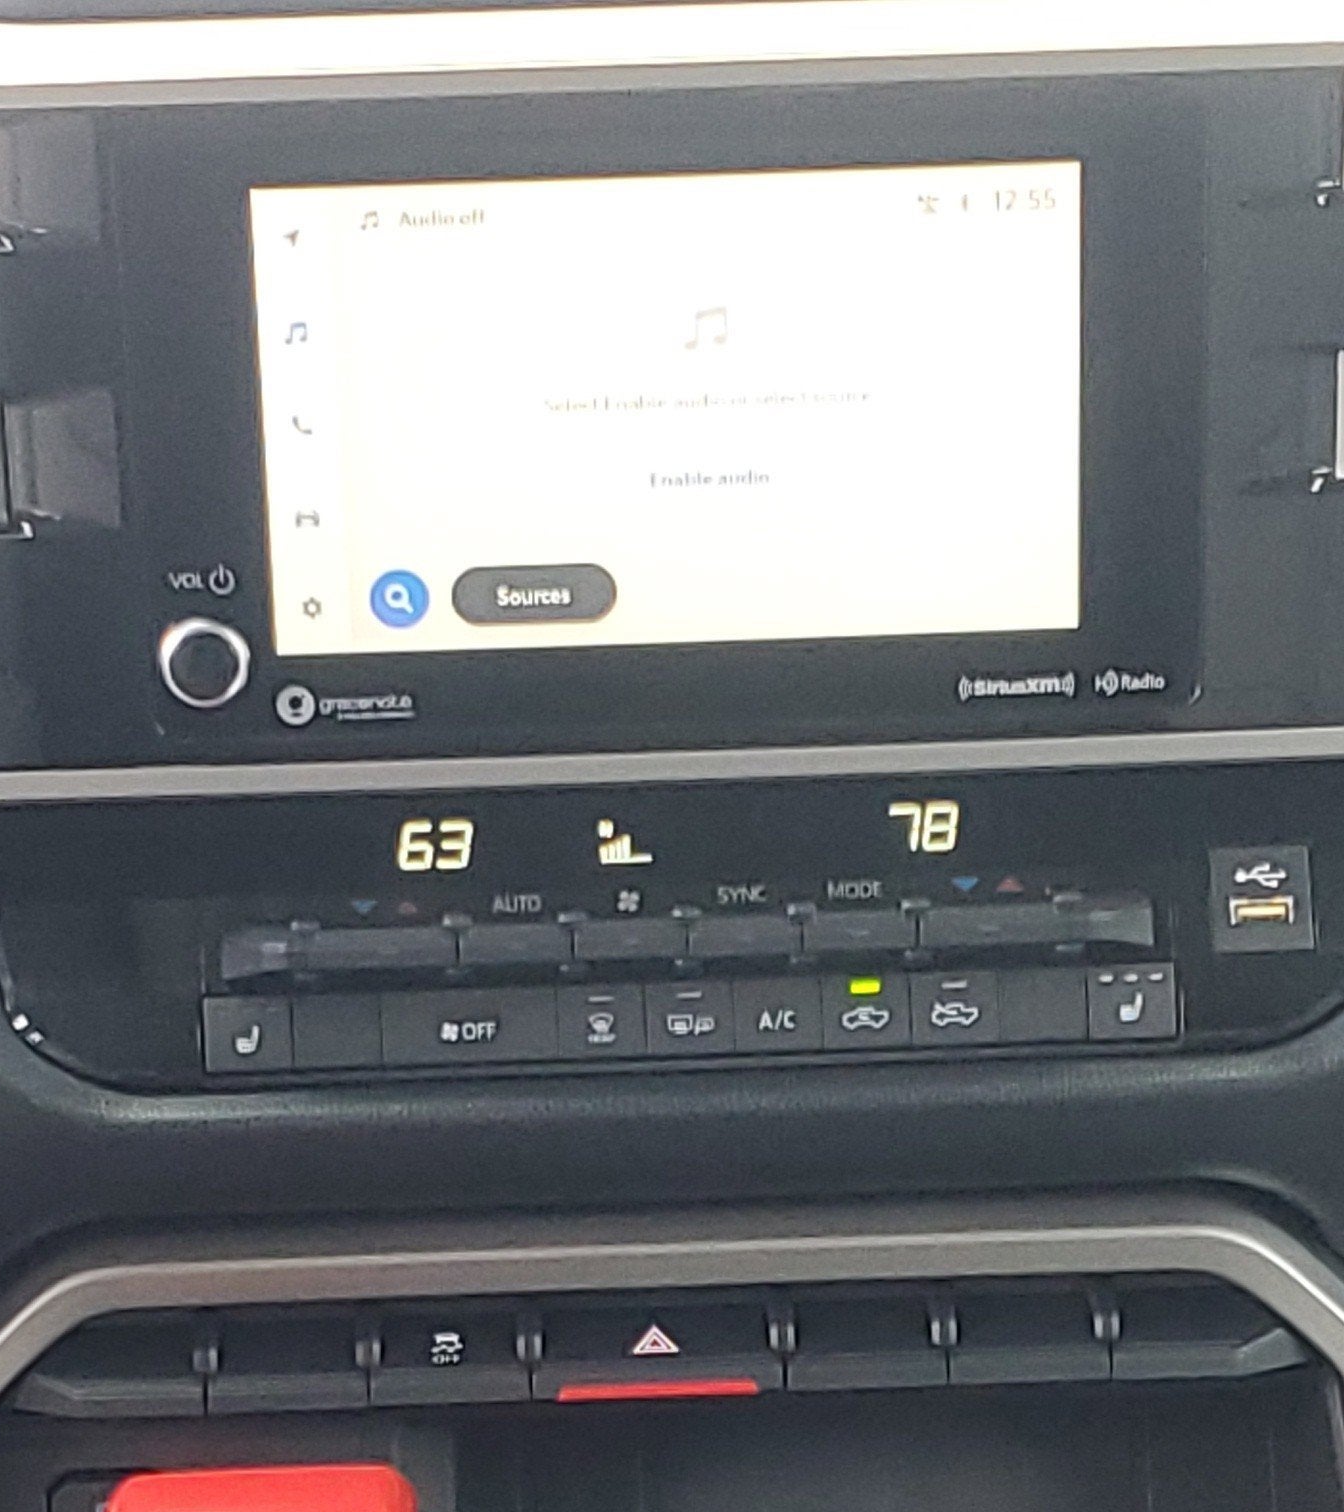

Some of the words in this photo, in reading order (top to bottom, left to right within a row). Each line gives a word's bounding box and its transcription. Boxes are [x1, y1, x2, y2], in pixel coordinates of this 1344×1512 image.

[399, 209, 455, 227] Audio
[458, 207, 486, 226] off
[650, 471, 713, 488] Enable
[717, 467, 771, 486] audio
[167, 571, 205, 590] VOL
[495, 583, 573, 608] Sources
[969, 672, 1064, 699] SiriusXM
[1120, 671, 1167, 691] Radio
[318, 692, 413, 716] gracenote
[888, 800, 961, 853] 78
[397, 817, 476, 873] 63
[716, 884, 768, 905] SYNC
[826, 879, 884, 901] MODE
[492, 893, 542, 915] AUTO
[461, 1020, 498, 1043] OFF
[758, 1008, 797, 1033] A/C
